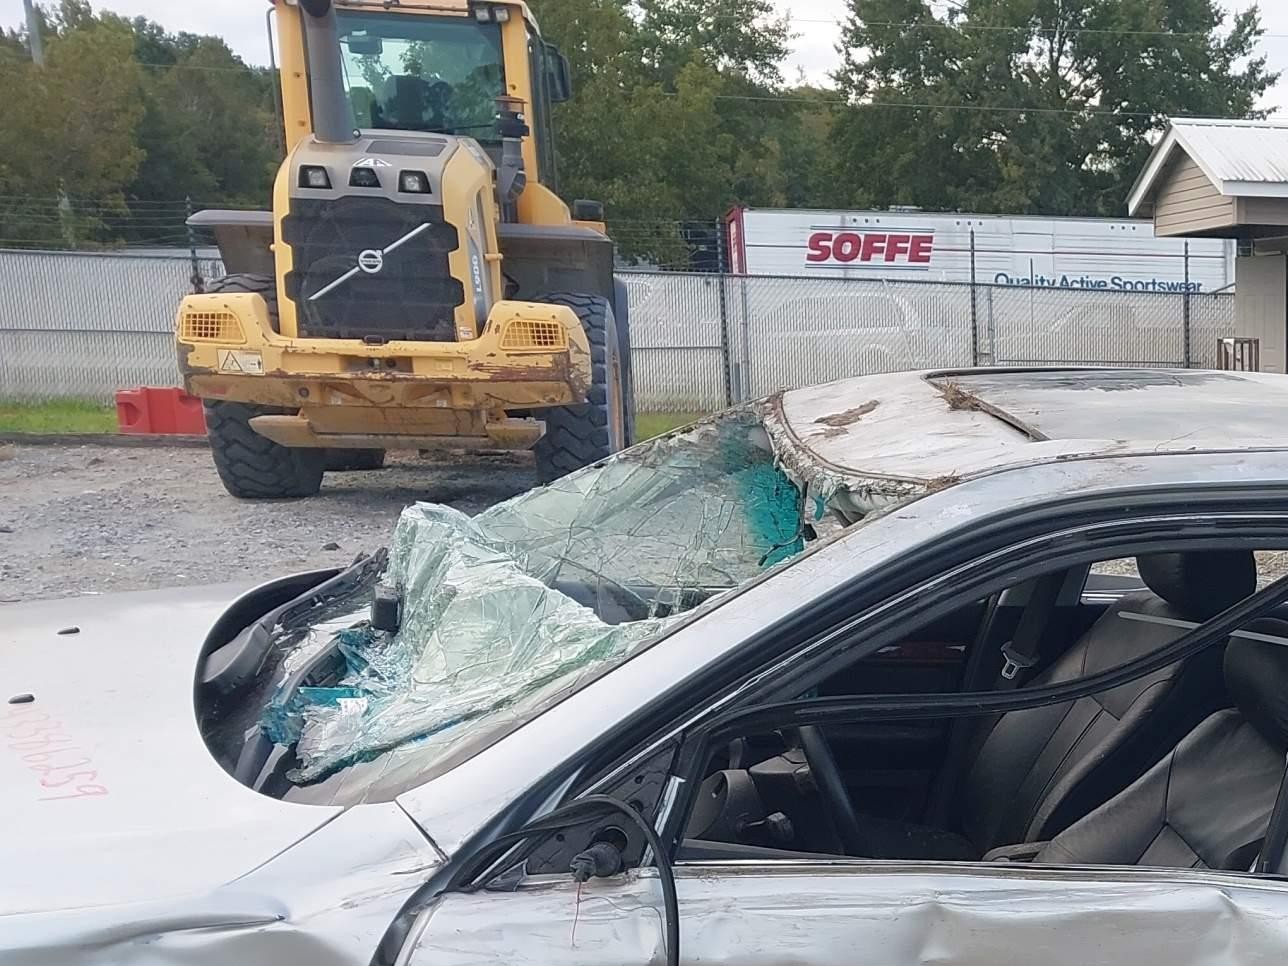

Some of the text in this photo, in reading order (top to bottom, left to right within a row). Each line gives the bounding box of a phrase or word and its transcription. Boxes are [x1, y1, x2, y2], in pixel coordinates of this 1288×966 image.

[806, 232, 934, 263] SOFFE
[994, 272, 1203, 293] Quaity Active Sportswear
